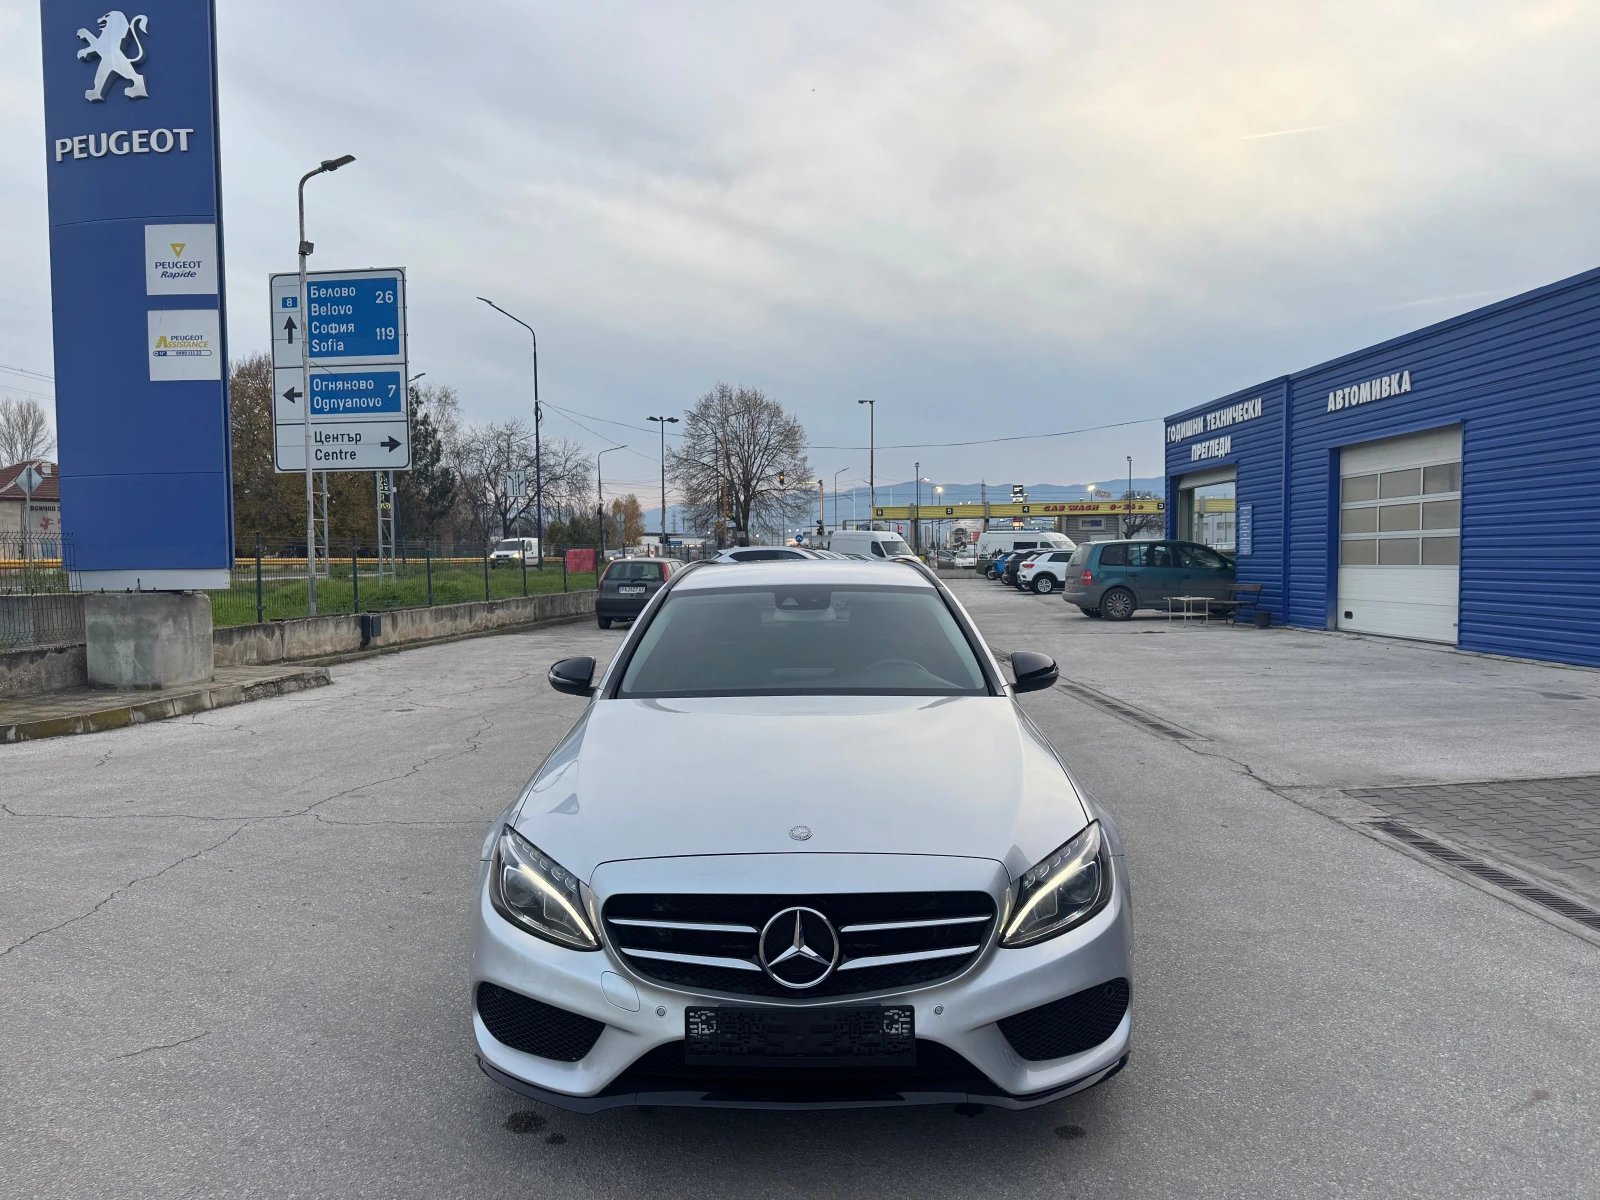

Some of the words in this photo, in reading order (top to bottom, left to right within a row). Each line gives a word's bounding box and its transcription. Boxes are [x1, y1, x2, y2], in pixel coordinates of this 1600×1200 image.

[55, 128, 194, 162] PEUGEOT
[155, 261, 202, 269] PEUGEOT
[160, 270, 197, 279] Rapide
[286, 298, 293, 307] 8
[310, 286, 356, 298] Белово
[375, 291, 394, 303] 26
[311, 303, 353, 316] Belovo
[311, 321, 355, 335] София
[376, 327, 395, 340] 119
[312, 339, 344, 352] Sofia
[313, 378, 374, 391] Огняново
[388, 385, 396, 397] 7
[1327, 370, 1411, 412] АВТОМИВКА
[313, 396, 382, 412] Ognyanovo
[1167, 416, 1204, 443] ГОДИШНИ
[1206, 397, 1262, 431] ТЕХНИЧЕСКИ
[314, 431, 363, 445] Център
[315, 448, 357, 461] Centre
[1191, 435, 1232, 461] ПРЕГЛЕДИ
